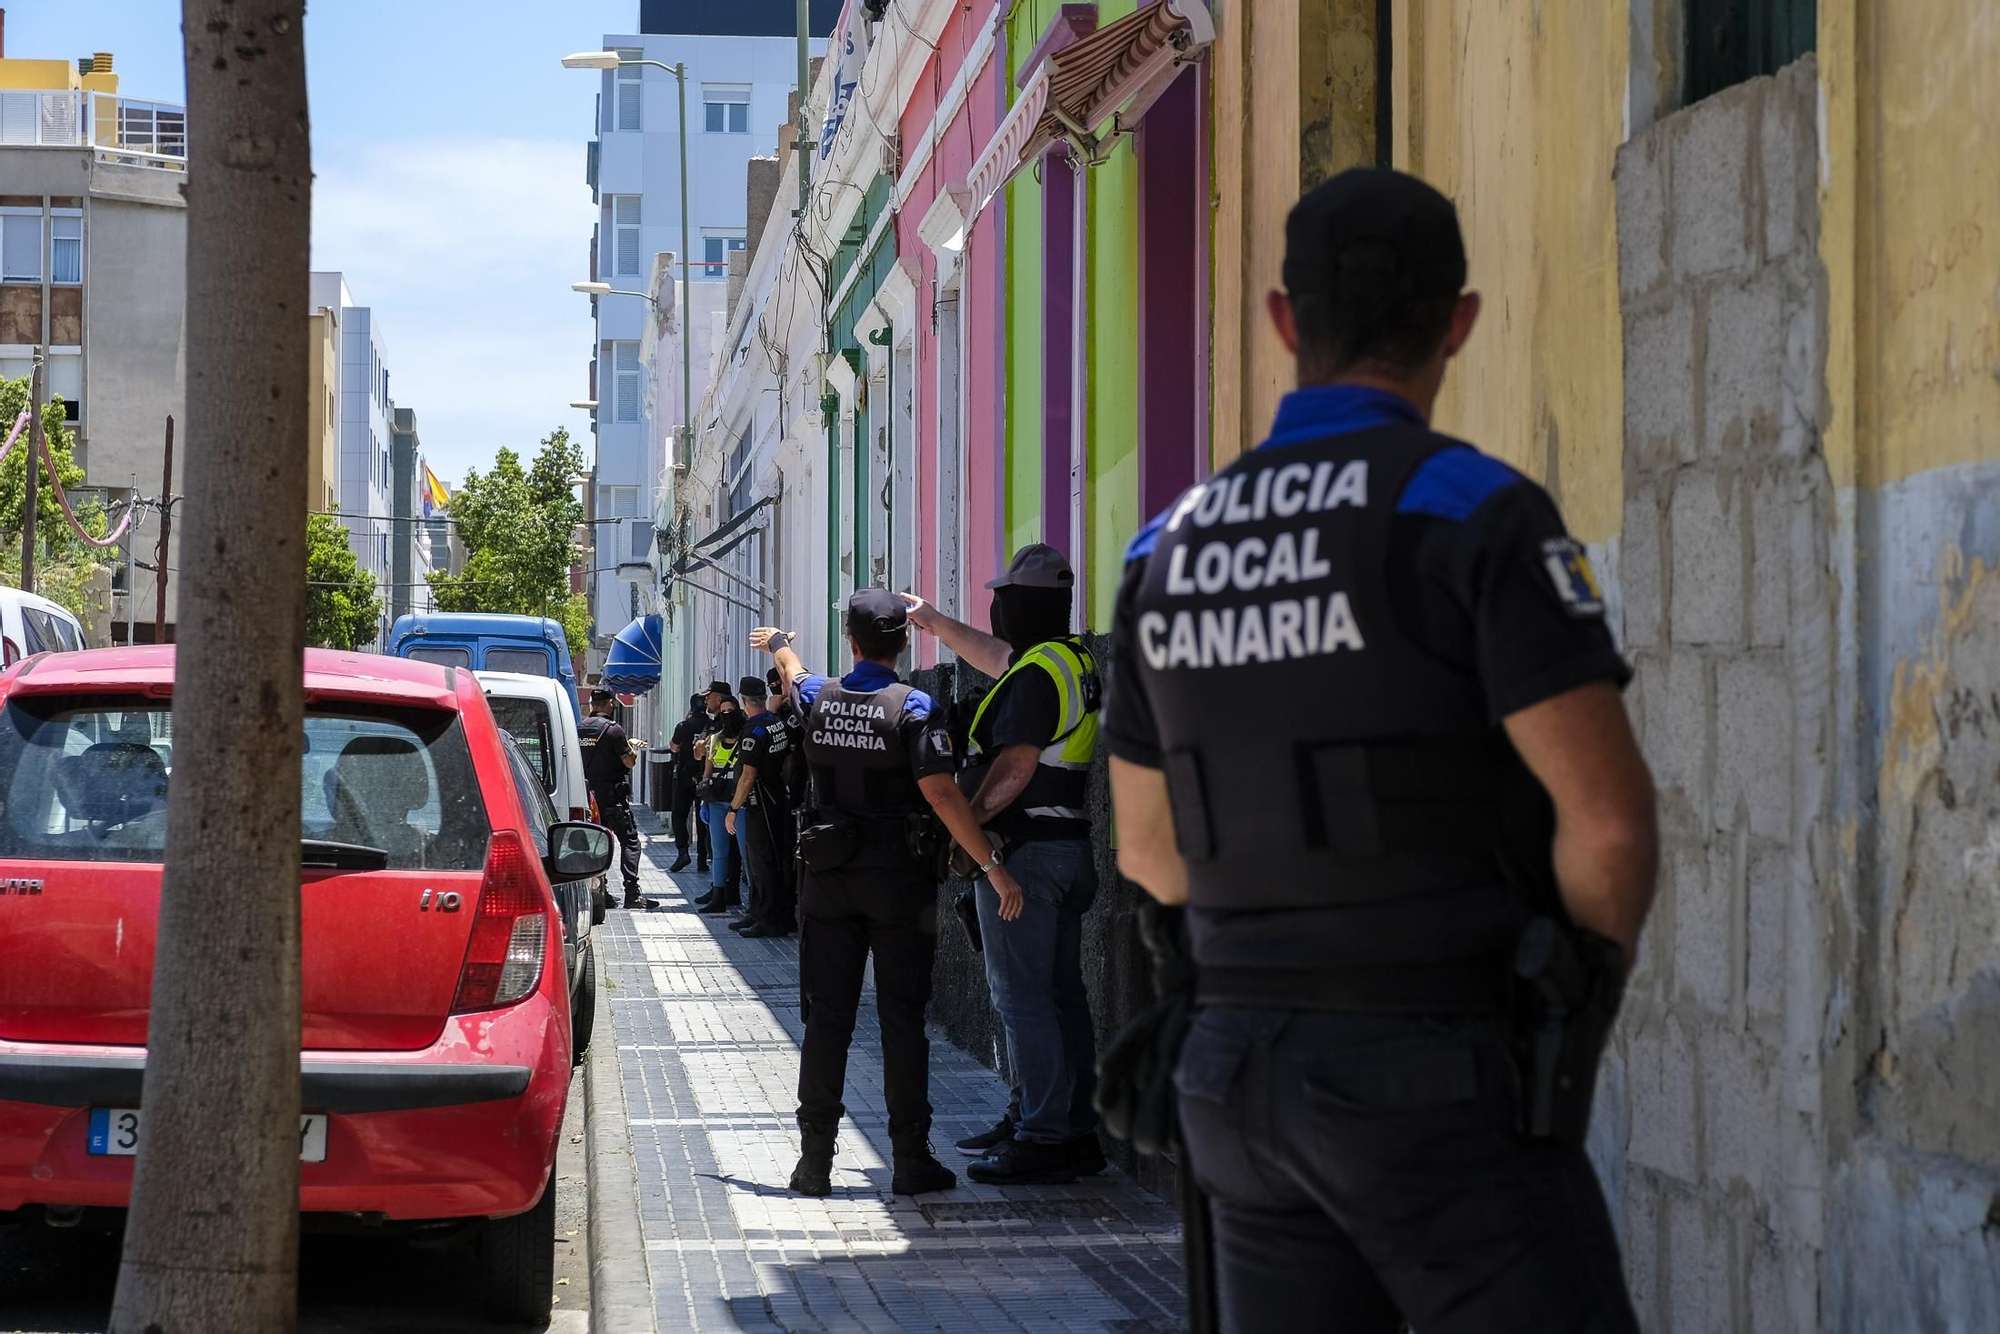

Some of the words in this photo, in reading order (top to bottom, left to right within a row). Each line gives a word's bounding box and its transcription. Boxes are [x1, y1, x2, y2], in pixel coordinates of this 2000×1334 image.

[1166, 460, 1368, 532] POLICIA
[1166, 528, 1330, 595] LOCAL
[1139, 592, 1365, 670] CANARIA
[820, 701, 885, 719] POLICIA
[825, 717, 874, 733] LOCAL
[812, 731, 886, 750] CANARIA
